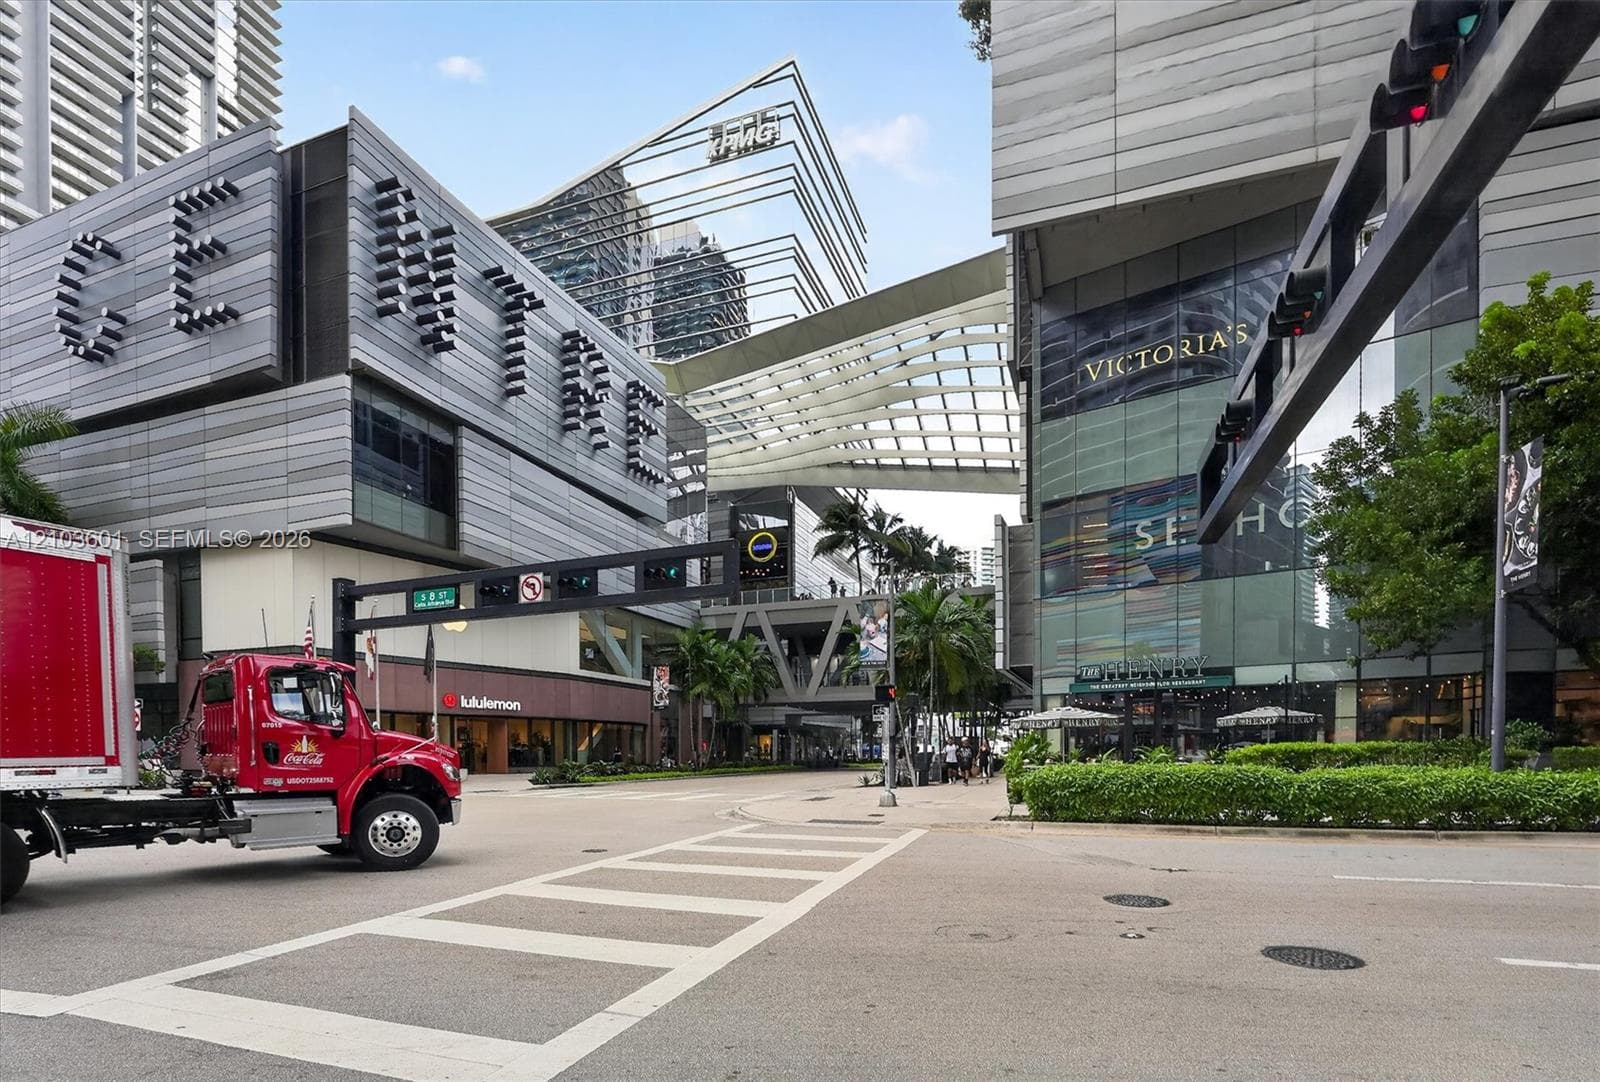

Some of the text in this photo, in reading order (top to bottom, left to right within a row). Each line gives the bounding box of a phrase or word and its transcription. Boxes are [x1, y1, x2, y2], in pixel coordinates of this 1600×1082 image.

[705, 120, 780, 160] KPMG
[1085, 323, 1249, 382] VICTORIA'S
[421, 591, 447, 601] S 8 ST
[1081, 655, 1209, 682] THE HENRY
[1171, 679, 1206, 687] RESTAURANT
[460, 695, 521, 711] lululemon
[1029, 719, 1059, 728] HENRY
[1069, 718, 1100, 727] HENRY
[1245, 716, 1278, 725] HENRY
[283, 752, 327, 765] Coca-Cola
